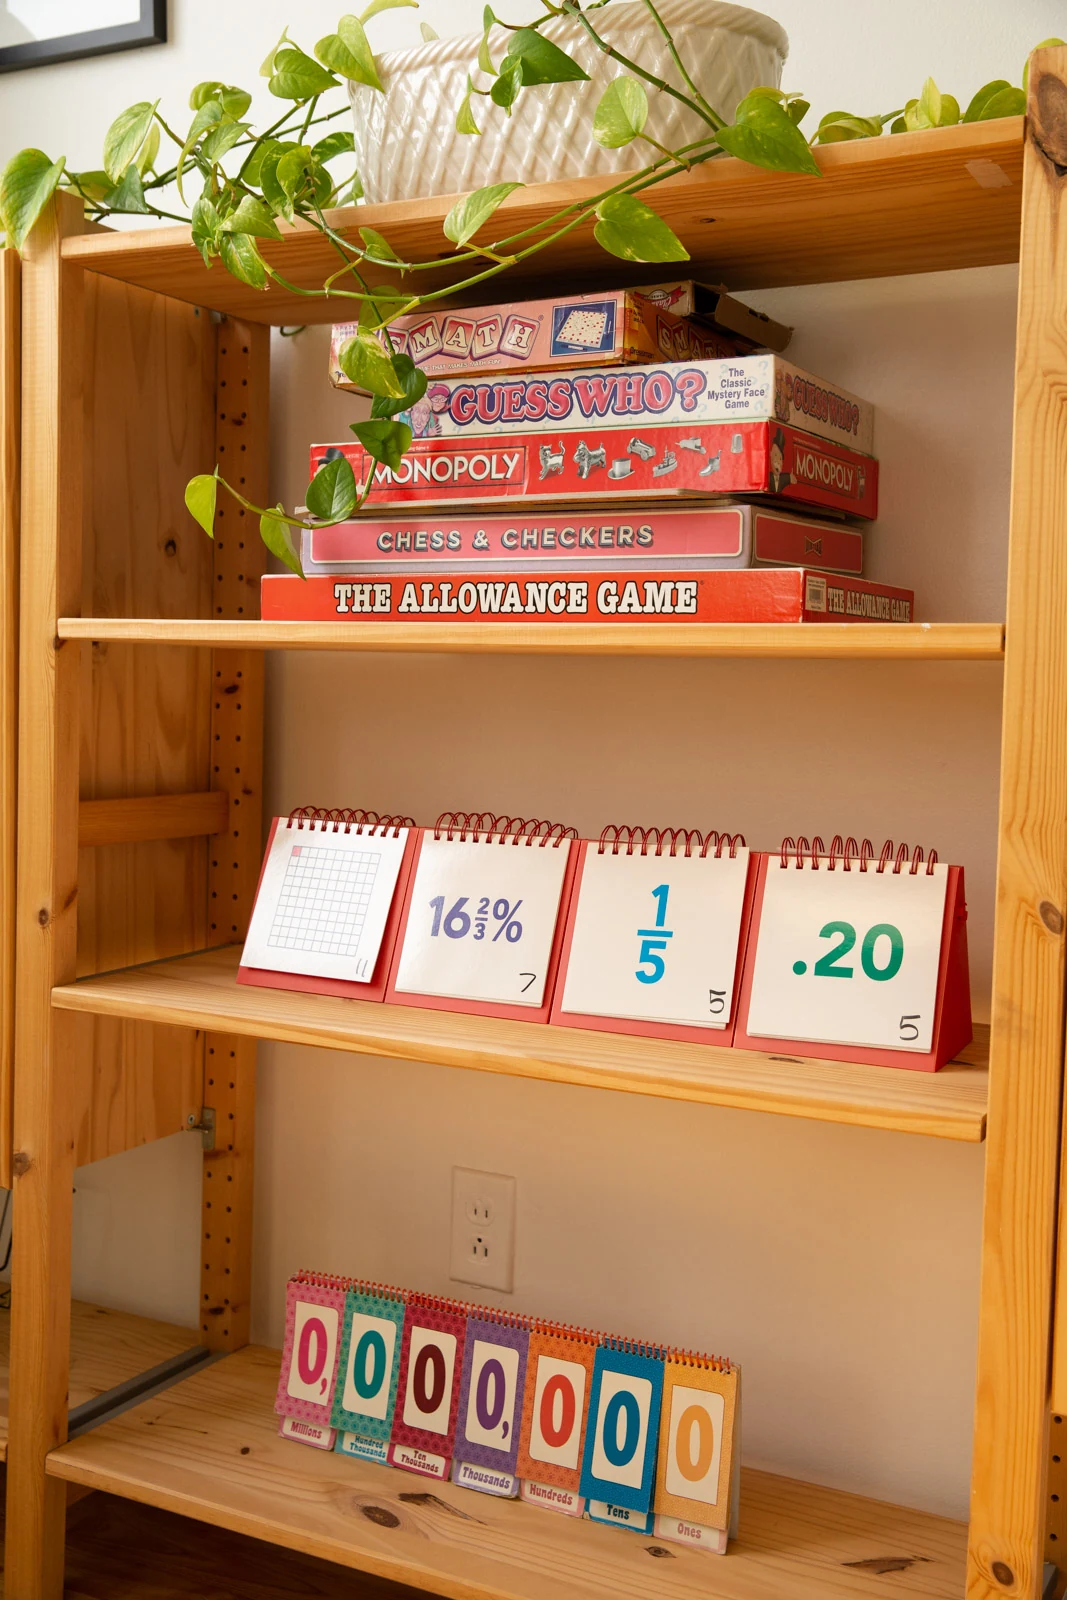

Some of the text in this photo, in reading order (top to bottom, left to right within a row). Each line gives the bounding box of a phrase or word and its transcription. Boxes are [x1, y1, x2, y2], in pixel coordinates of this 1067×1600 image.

[662, 327, 724, 359] SMAT
[720, 377, 752, 388] Classic
[728, 368, 745, 377] The
[449, 369, 706, 425] GUESS WHO?
[707, 388, 765, 400] Mystery Face
[725, 399, 750, 409] Game
[793, 376, 860, 435] GUESS WHO?
[371, 453, 520, 486] MONOPOLY
[796, 454, 854, 492] MONOPOLY
[377, 524, 654, 552] CHESS & CHECKERS
[334, 580, 698, 614] THE ALLOWANCE GAME
[828, 586, 910, 622] THE ALLOWANCE GAME
[792, 920, 904, 982] .20
[519, 973, 537, 992] 7
[709, 989, 727, 1014] 5
[899, 1014, 921, 1041] 5
[354, 1330, 386, 1400] 0
[413, 1344, 446, 1414] 0
[540, 1374, 576, 1448] 0
[290, 1421, 322, 1440] Millions
[603, 1390, 640, 1467] 0
[349, 1442, 386, 1459] Thousands
[355, 1435, 384, 1449] Hundred
[676, 1404, 714, 1482] 0
[401, 1454, 439, 1474] Thousands
[413, 1450, 427, 1461] Ten
[462, 1466, 511, 1489] Thousands
[529, 1483, 573, 1506] Hundreds
[606, 1504, 630, 1521] Tens
[677, 1522, 702, 1539] Ones
